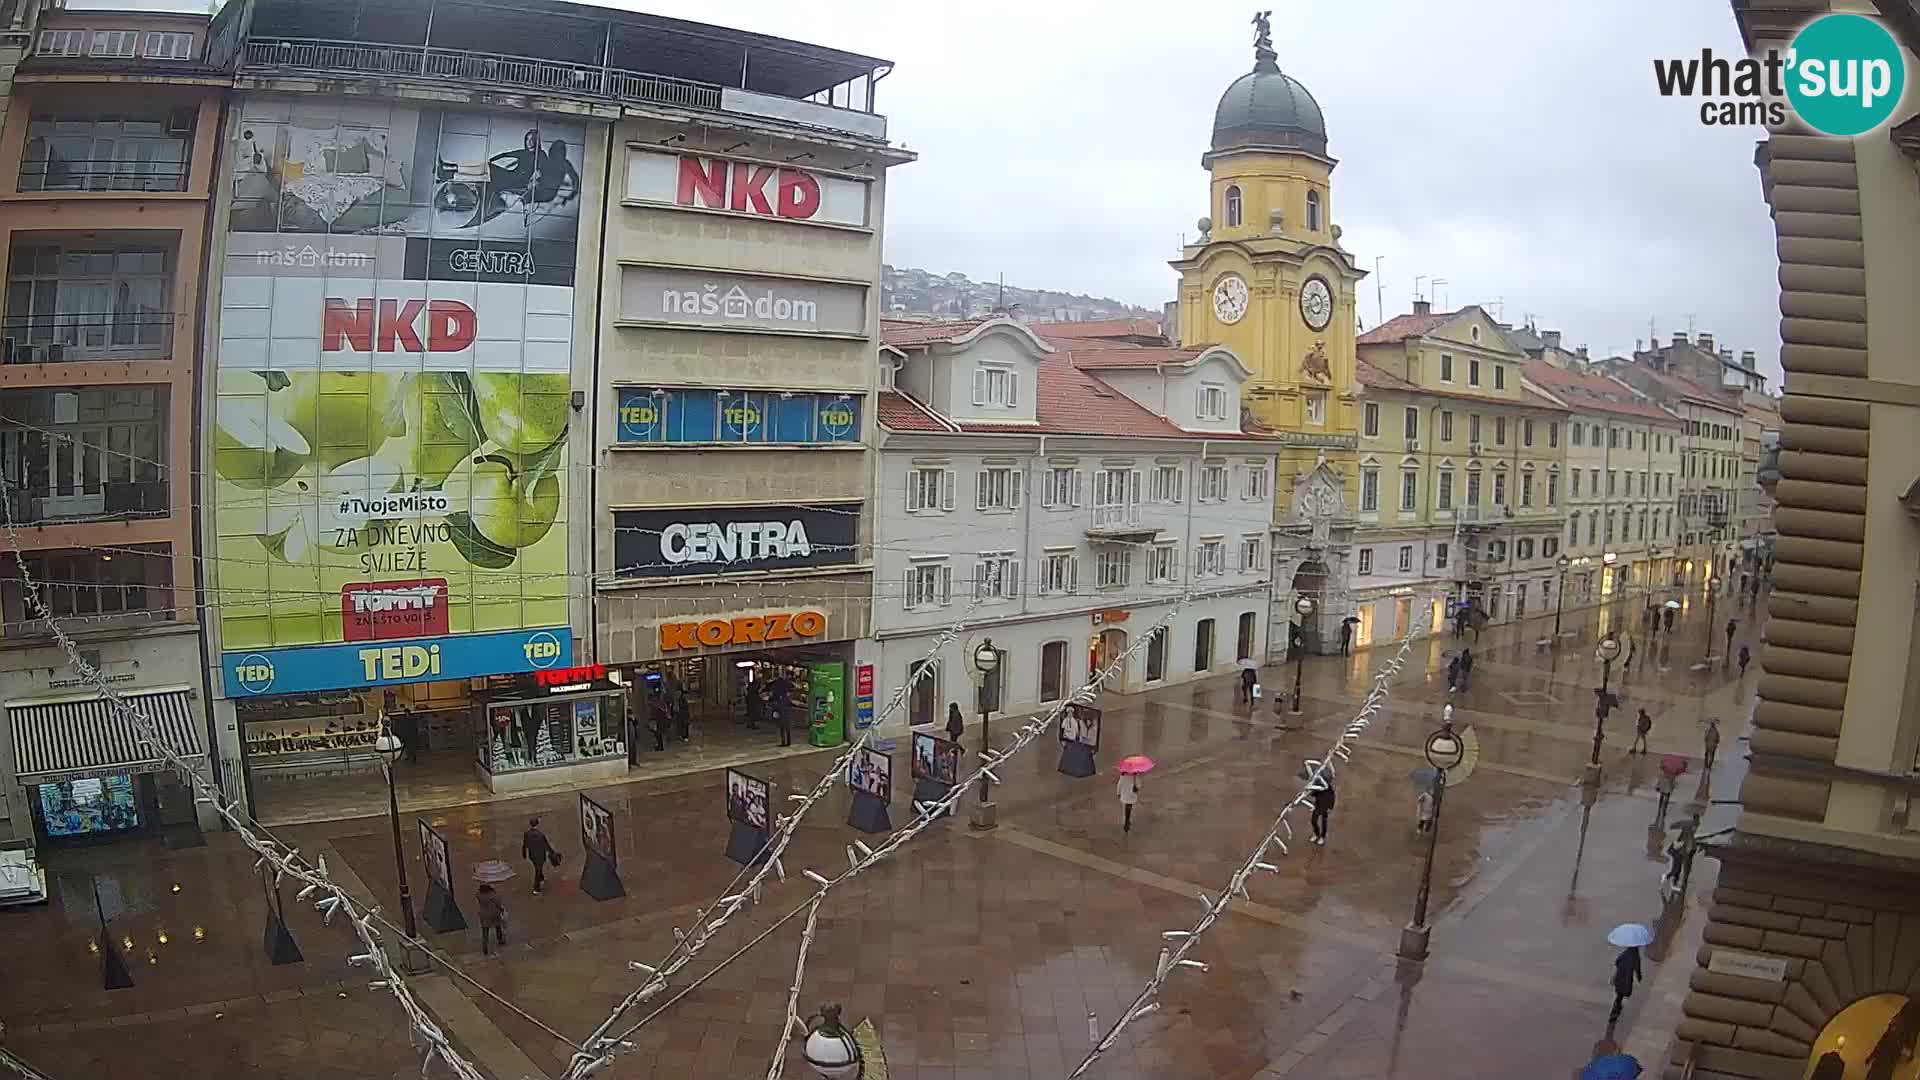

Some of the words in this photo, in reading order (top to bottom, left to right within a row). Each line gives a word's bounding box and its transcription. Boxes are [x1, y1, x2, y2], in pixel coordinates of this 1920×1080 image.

[676, 157, 821, 219] NKD
[257, 245, 298, 266] naš
[320, 247, 367, 267] dom
[450, 249, 536, 275] CENTRA
[662, 284, 719, 316] naš
[755, 290, 817, 322] dom
[322, 297, 478, 352] NKD
[619, 407, 659, 424] TEDi
[725, 409, 760, 425] TEDi
[820, 410, 853, 426] TEDi
[340, 495, 447, 515] #TvojeMisto
[336, 527, 359, 548] ZA
[367, 522, 452, 547] DNEVNO
[660, 519, 811, 563] CENTRA
[361, 546, 428, 574] SVJEŽE
[350, 586, 438, 613] TOMMY
[660, 611, 826, 652] KORZO
[359, 643, 442, 681] TEDi
[523, 640, 561, 659] TEDi
[236, 664, 275, 683] TEDi
